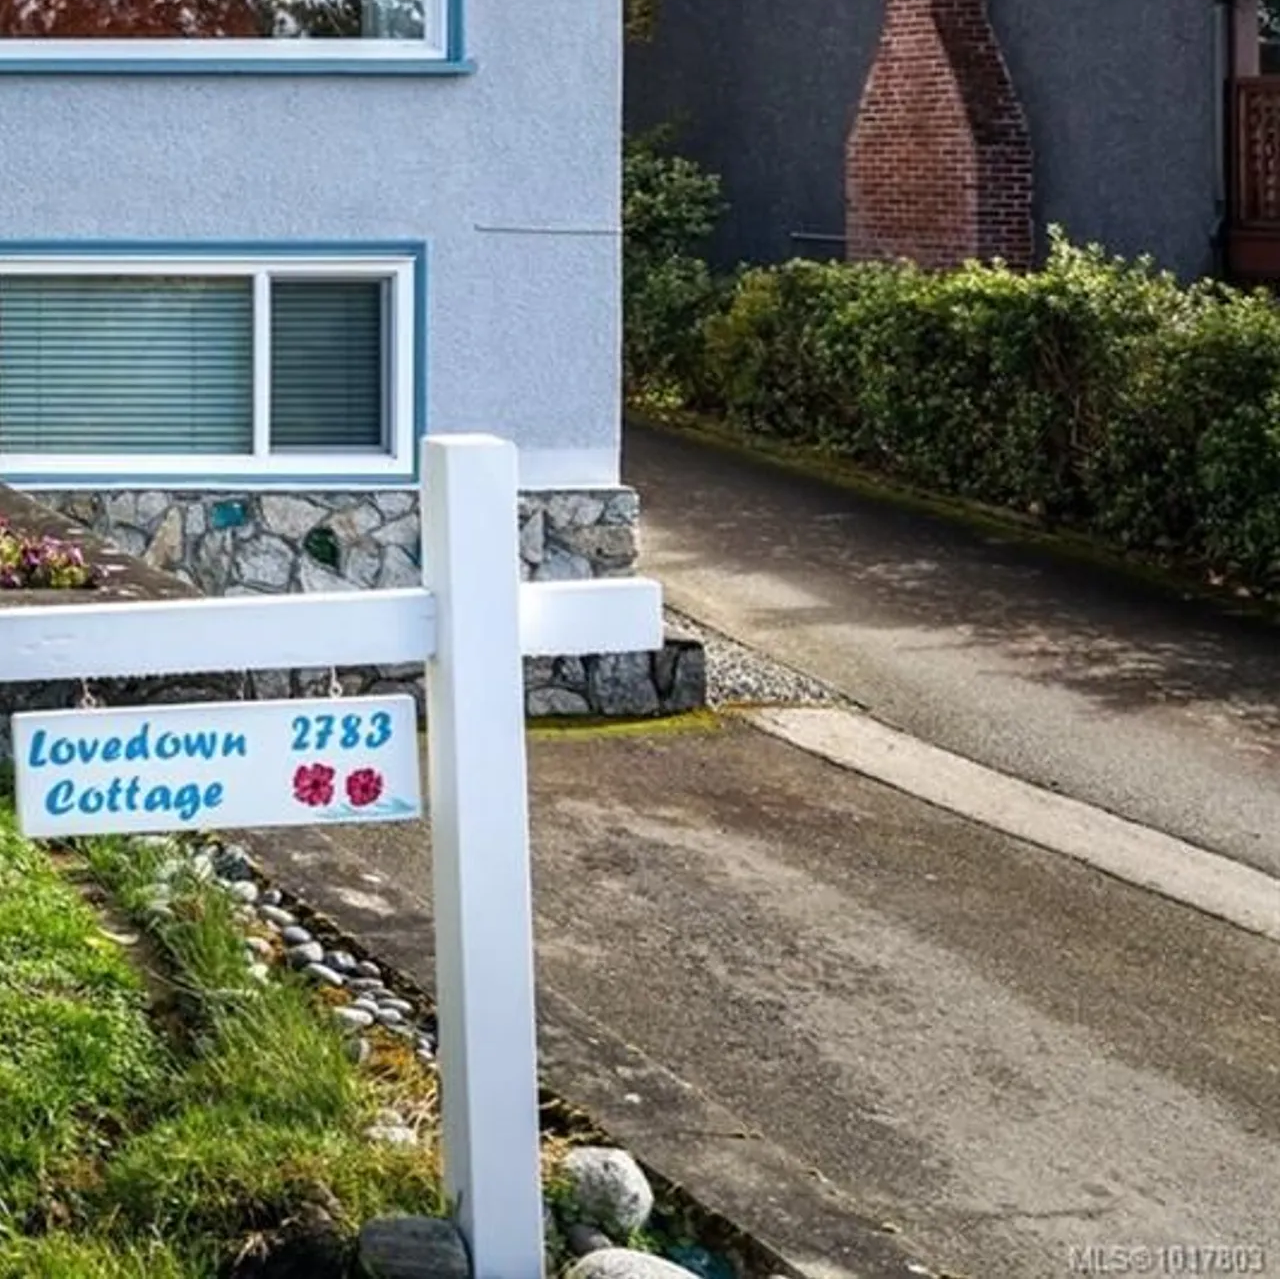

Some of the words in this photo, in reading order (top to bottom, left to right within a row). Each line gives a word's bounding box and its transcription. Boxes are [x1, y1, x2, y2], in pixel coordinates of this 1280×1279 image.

[28, 723, 247, 768] Lovedown
[292, 711, 393, 751] 2783
[44, 778, 224, 821] Cottage
